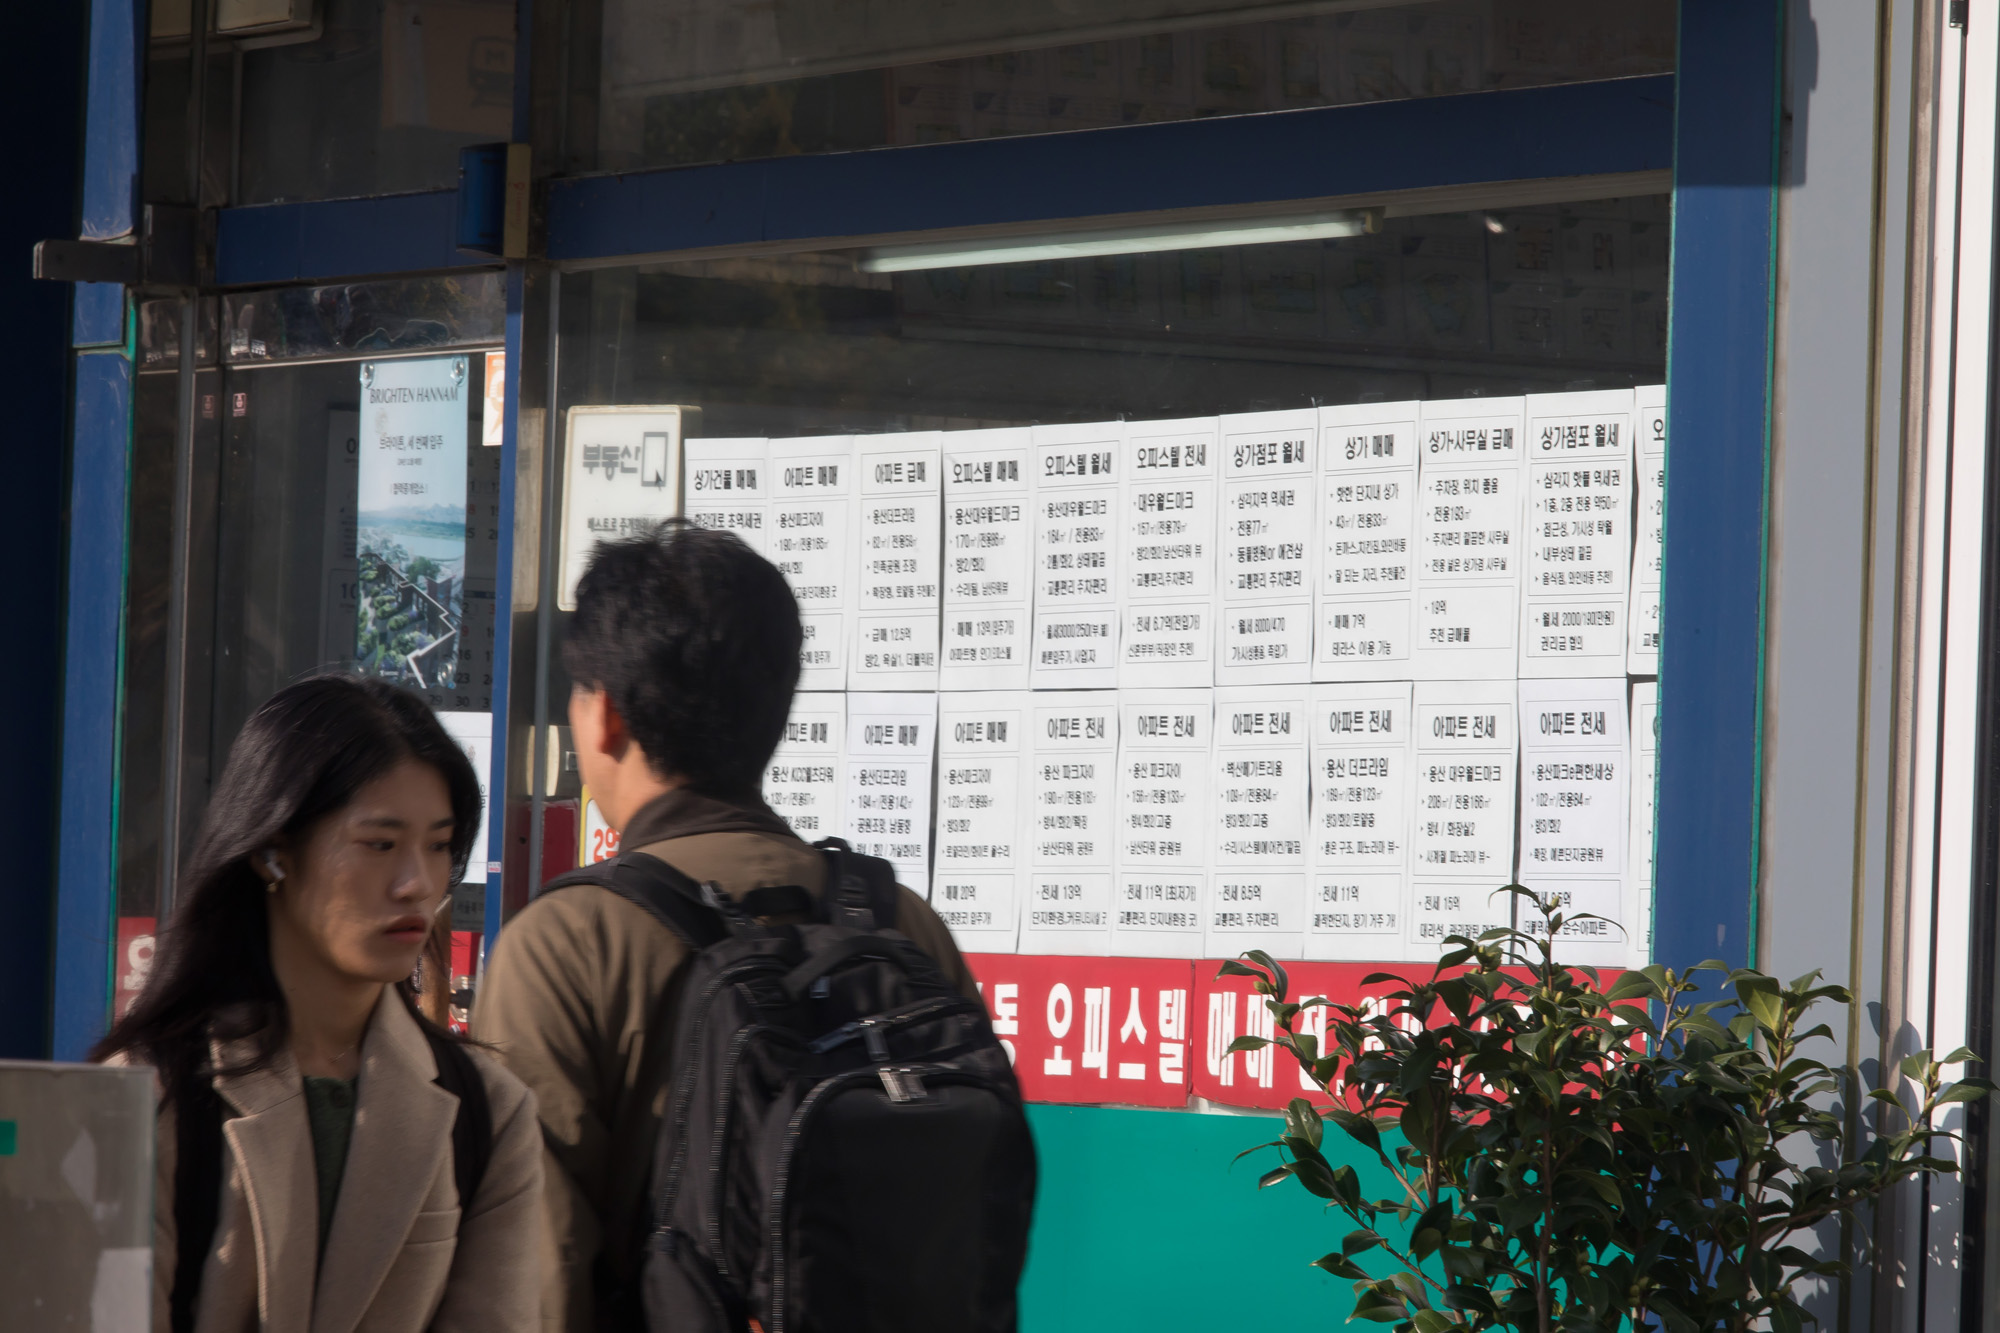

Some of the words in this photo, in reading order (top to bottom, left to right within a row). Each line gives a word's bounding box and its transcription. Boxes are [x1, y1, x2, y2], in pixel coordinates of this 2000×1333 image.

[370, 388, 415, 404] BRIGHTEN
[416, 386, 458, 403] HANNAM
[1492, 428, 1514, 449] 급매
[1541, 425, 1589, 450] 상가점포
[1595, 423, 1619, 447] 월세
[1234, 443, 1277, 468] 상가점포
[1282, 440, 1305, 463] 월세
[1345, 436, 1368, 459] 상가
[1372, 434, 1394, 457] 매매
[583, 444, 641, 481] 부동산
[1045, 454, 1087, 476] 오피스텔
[1091, 452, 1112, 474] 월세
[1137, 446, 1180, 468] 오피스텔
[1184, 444, 1206, 467] 전세
[695, 470, 732, 490] 상가건물
[736, 469, 757, 490] 매매
[785, 467, 814, 488] 아파트
[818, 465, 838, 486] 매매
[875, 463, 903, 483] 아파트
[907, 461, 926, 482] 급매
[953, 462, 992, 484] 오피스텔
[997, 460, 1018, 482] 매매
[1544, 471, 1570, 489] 삼각지
[1573, 470, 1590, 488] 핫플
[1594, 469, 1620, 487] 역세권
[1357, 484, 1380, 501] 단지내
[1383, 483, 1399, 500] 상가
[1463, 478, 1479, 495] 위치
[1483, 477, 1498, 494] 좋음
[1138, 491, 1193, 512] 대우월드마크
[1238, 491, 1268, 509] 삼각지역
[1270, 490, 1295, 507] 역세권
[1576, 497, 1591, 511] 전용
[955, 506, 1020, 525] 용산대우월드마크
[1047, 500, 1107, 518] 용산대우월드마크
[1487, 530, 1509, 545] 사무실
[1572, 521, 1594, 536] 가시성
[1543, 547, 1575, 562] 내부상태
[1578, 546, 1592, 561] 깔끔
[1486, 557, 1507, 571] 사무실
[1077, 578, 1107, 595] 주차편리
[1238, 573, 1266, 590] 교통편리
[1269, 570, 1301, 587] 주차편리
[1136, 616, 1150, 632] 전세
[1353, 613, 1366, 628] 7억
[1543, 612, 1559, 627] 월세
[1332, 642, 1356, 657] 테라스
[1359, 641, 1375, 656] 이용
[1541, 636, 1566, 651] 권리금
[1048, 718, 1080, 739] 아파트
[1086, 717, 1105, 739] 전세
[1138, 715, 1168, 737] 아파트
[1173, 715, 1195, 737] 전세
[1232, 713, 1264, 735] 아파트
[1269, 712, 1291, 734] 전세
[1330, 711, 1364, 734] 아파트
[1369, 709, 1392, 733] 전세
[1433, 716, 1468, 739] 아파트
[1473, 715, 1496, 738] 전세
[1540, 712, 1575, 736] 아파트
[1581, 711, 1605, 735] 전세
[810, 723, 828, 743] 매매
[865, 725, 893, 745] 아파트
[899, 725, 919, 746] 매매
[955, 722, 983, 744] 아파트
[987, 721, 1008, 743] 매매
[772, 767, 788, 783] 용산
[1044, 765, 1060, 781] 용산
[1063, 764, 1094, 780] 파크자이
[1133, 763, 1147, 779] 용산
[1150, 763, 1181, 778] 파크자이
[1327, 758, 1345, 778] 용산
[1349, 758, 1388, 777] 더프라임
[1429, 766, 1446, 783] 용산
[1449, 765, 1501, 782] 대우월드마크
[1536, 764, 1614, 781] 용산파크e편한세상
[860, 769, 907, 786] 용산더프라임
[1043, 842, 1074, 856] 남산타워
[1041, 885, 1059, 901] 전세
[1063, 885, 1082, 900] 13억
[1128, 884, 1142, 900] 전세
[1145, 885, 1162, 900] 11억
[1223, 885, 1238, 901] 전세
[1323, 886, 1338, 902] 전세
[1341, 886, 1359, 901] 11억
[1424, 896, 1440, 911] 전세
[1444, 896, 1460, 911] 15억
[1246, 913, 1278, 927] 주차편리
[1044, 983, 1186, 1085] 오피스텔
[1207, 991, 1275, 1088] 매매
